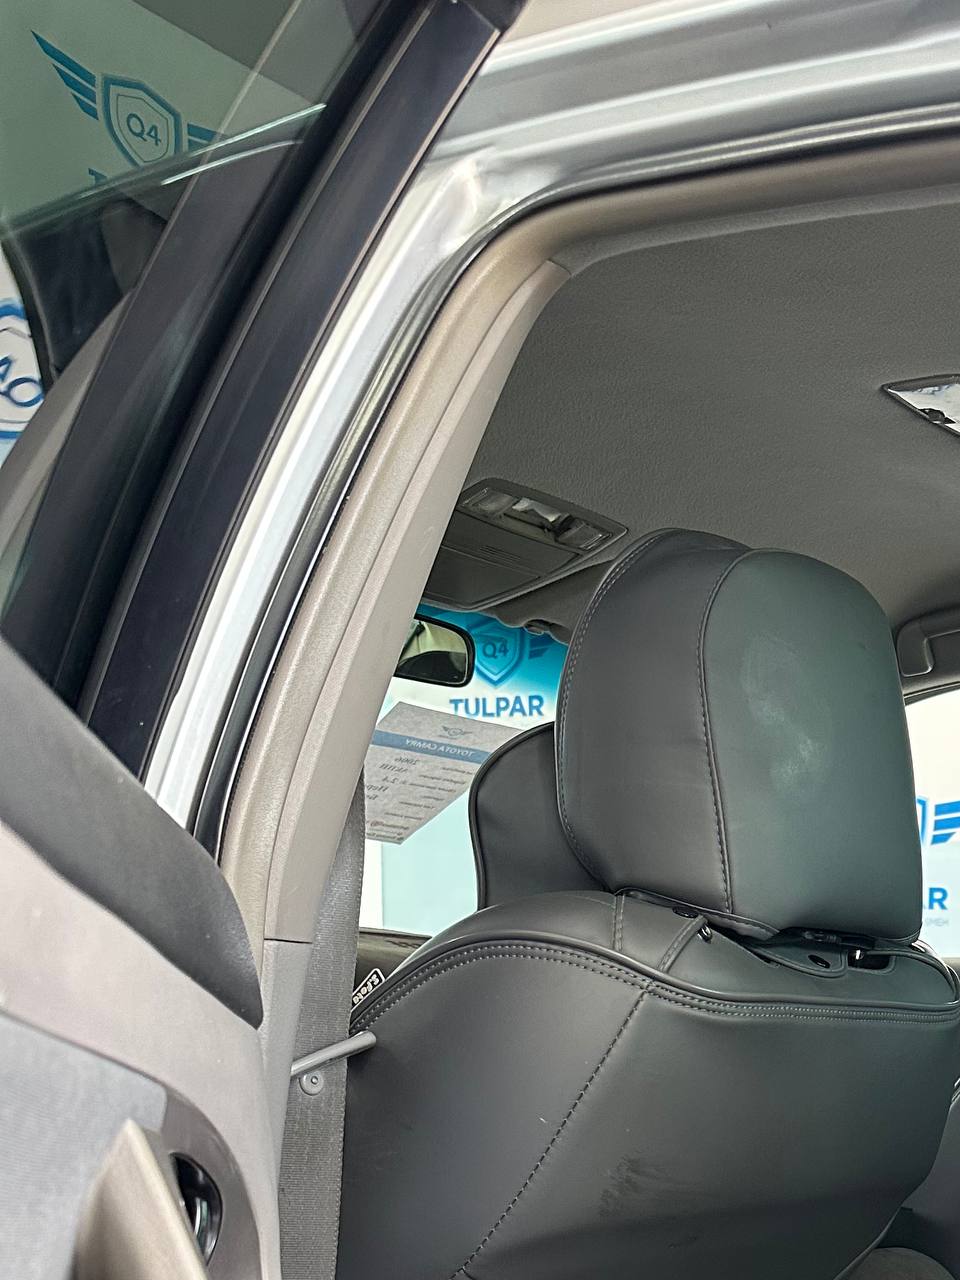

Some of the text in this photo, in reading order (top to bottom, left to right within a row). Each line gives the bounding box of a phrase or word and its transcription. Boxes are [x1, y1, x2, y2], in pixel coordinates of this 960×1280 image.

[126, 112, 161, 146] Q4
[481, 641, 509, 659] Q4
[449, 694, 545, 717] TULPAR
